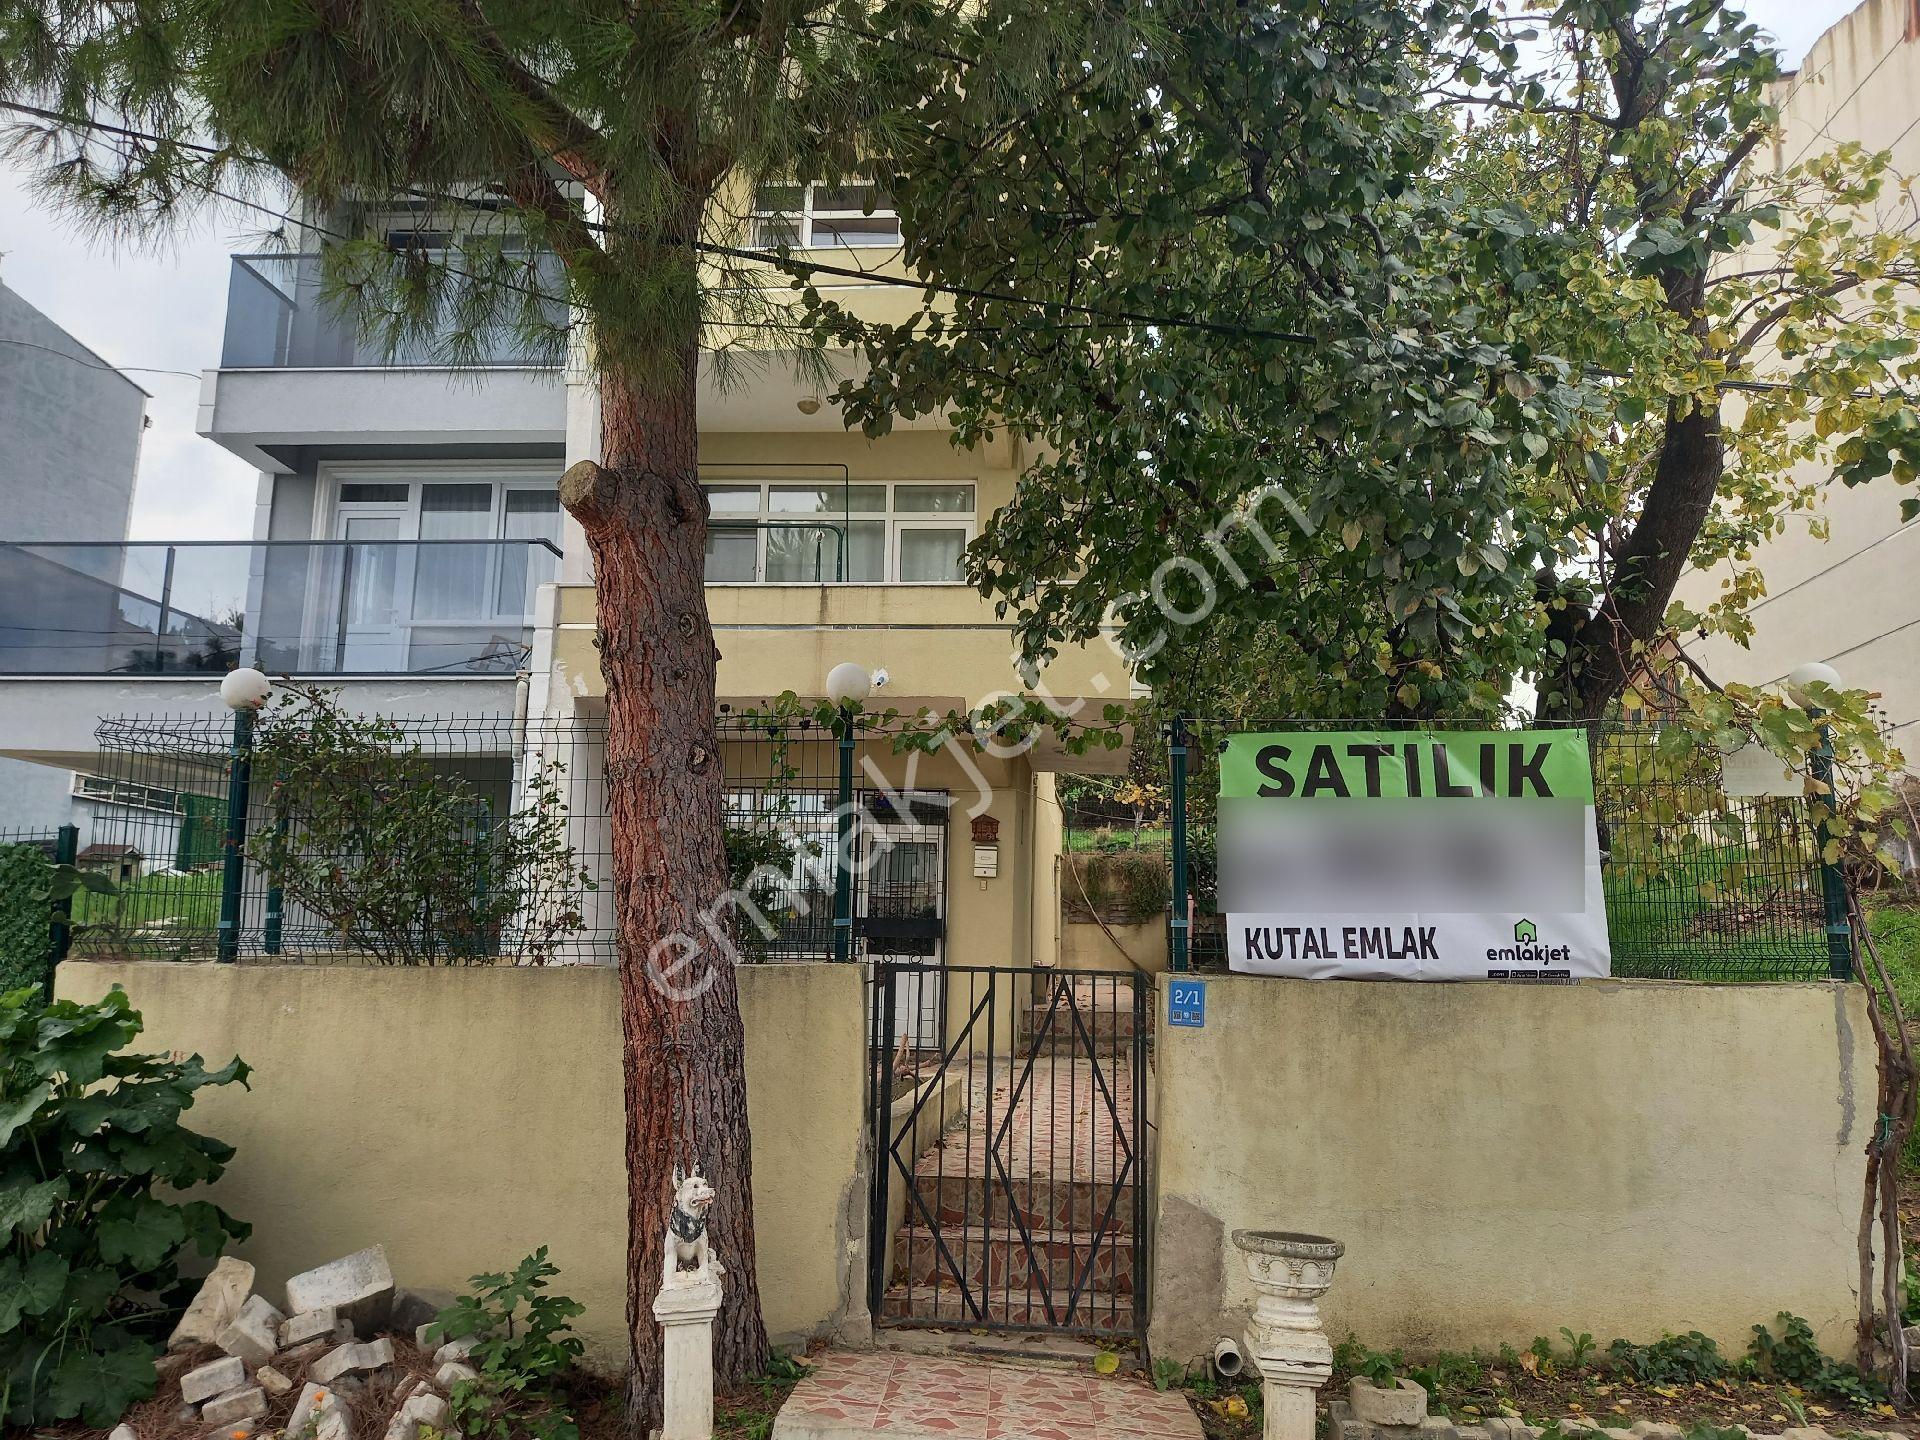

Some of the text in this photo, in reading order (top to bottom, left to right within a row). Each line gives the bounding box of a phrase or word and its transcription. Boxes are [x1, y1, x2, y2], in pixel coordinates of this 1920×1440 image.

[1255, 742, 1554, 798] SATILIK
[1245, 926, 1440, 960] KUTAL EMLAK
[1486, 944, 1570, 965] emlakjet
[1174, 989, 1200, 1005] 2/1
